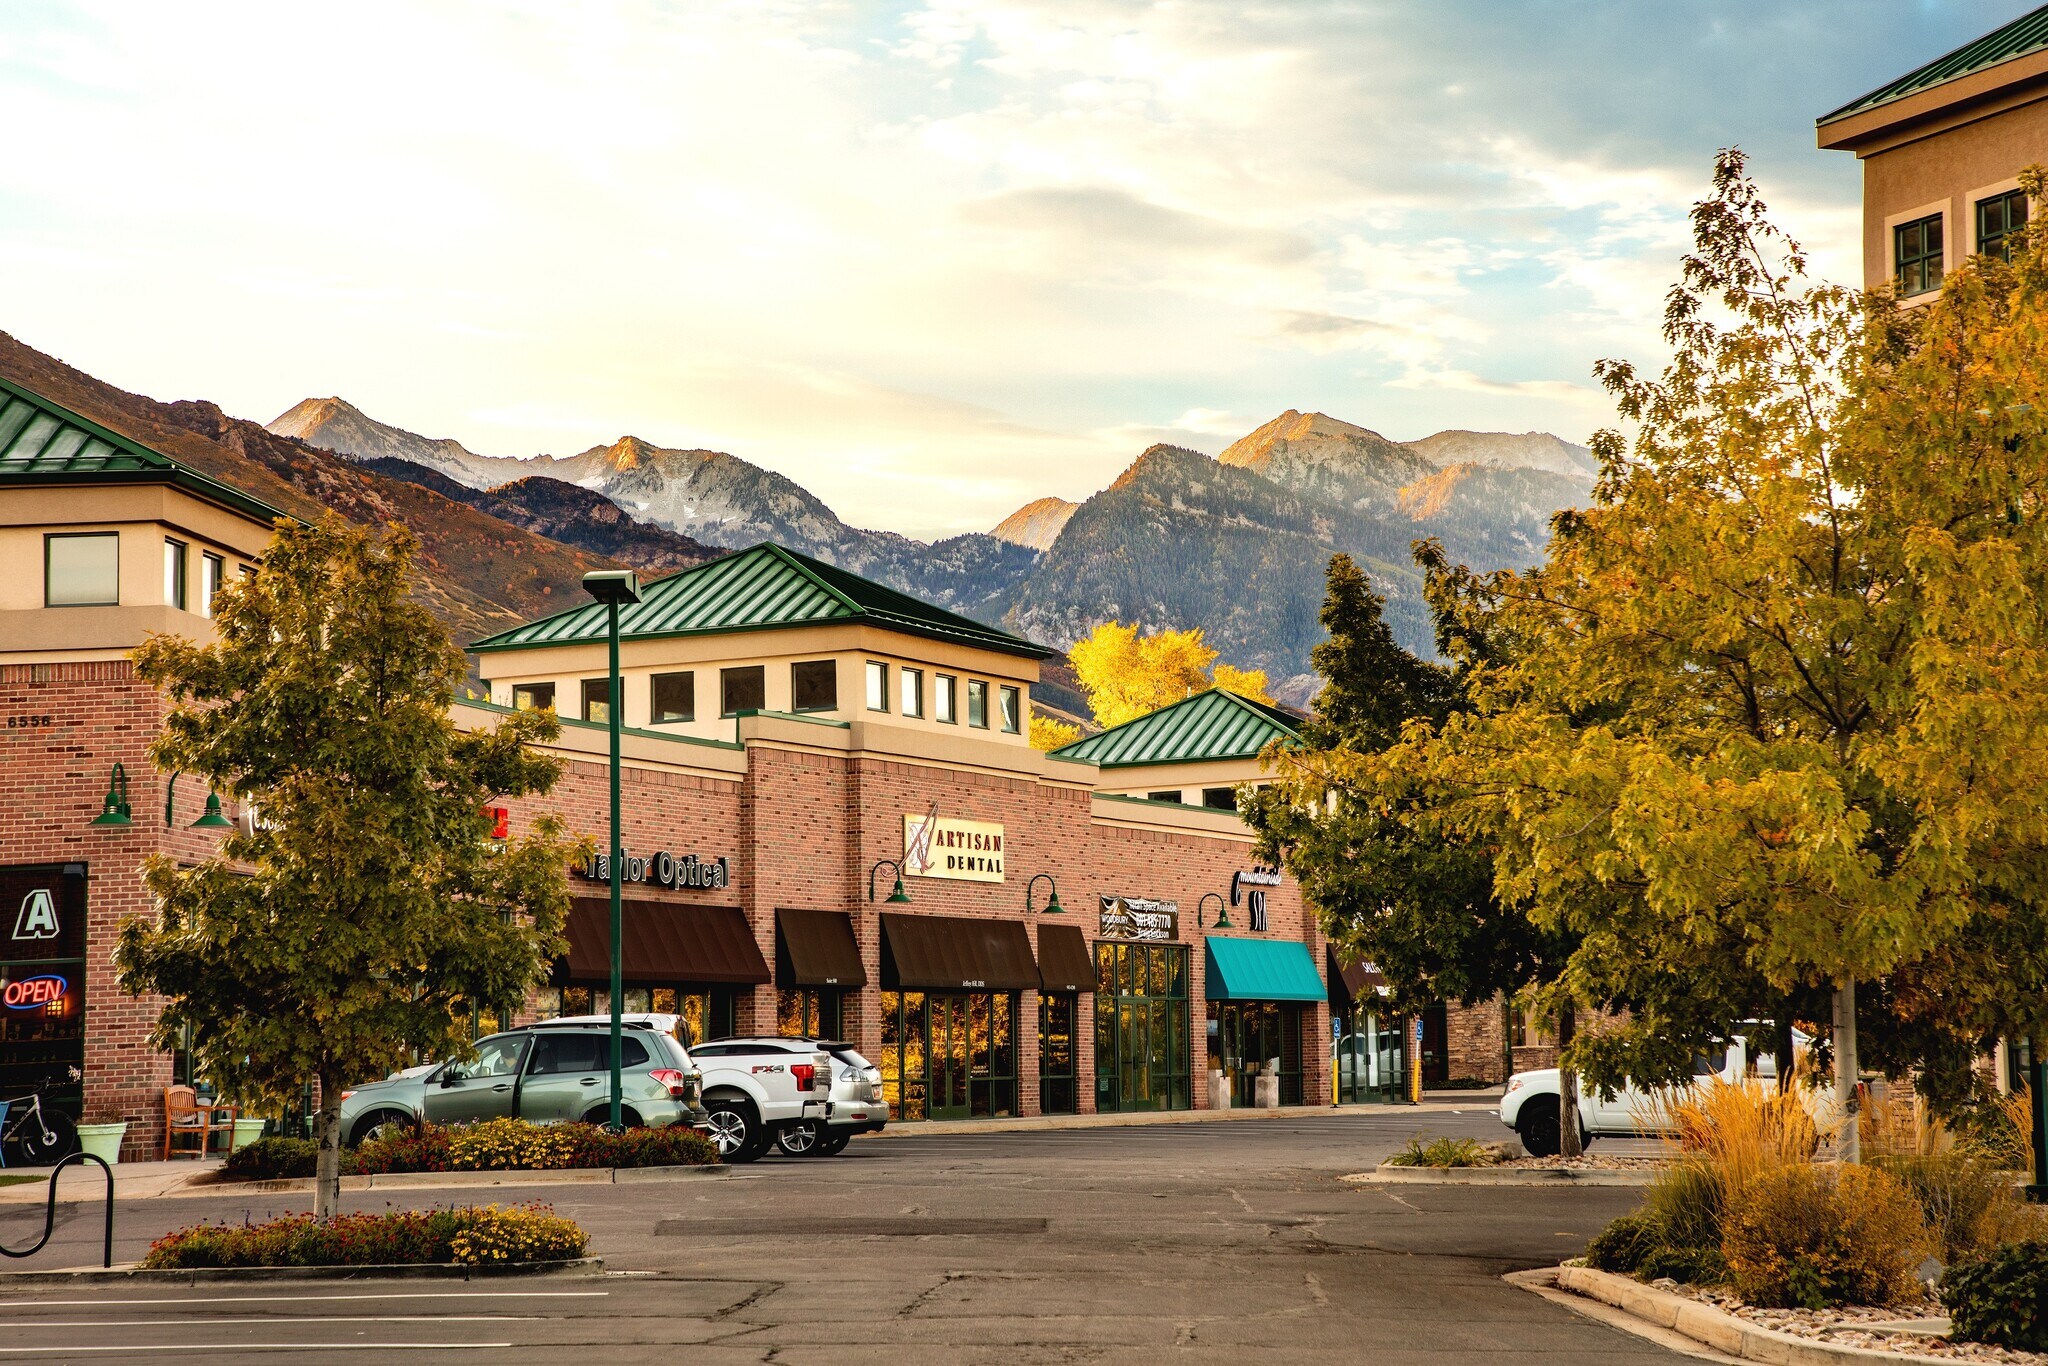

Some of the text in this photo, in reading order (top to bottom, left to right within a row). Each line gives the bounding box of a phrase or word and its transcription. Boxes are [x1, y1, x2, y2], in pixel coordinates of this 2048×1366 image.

[8, 716, 50, 728] 6556
[936, 829, 1002, 852] ARTISAN
[589, 846, 730, 891] Talor Optical
[947, 855, 1003, 874] DENTAL
[11, 889, 60, 940] A
[1253, 890, 1268, 931] SPA
[4, 980, 62, 1005] OPEN
[751, 1064, 785, 1075] FX4
